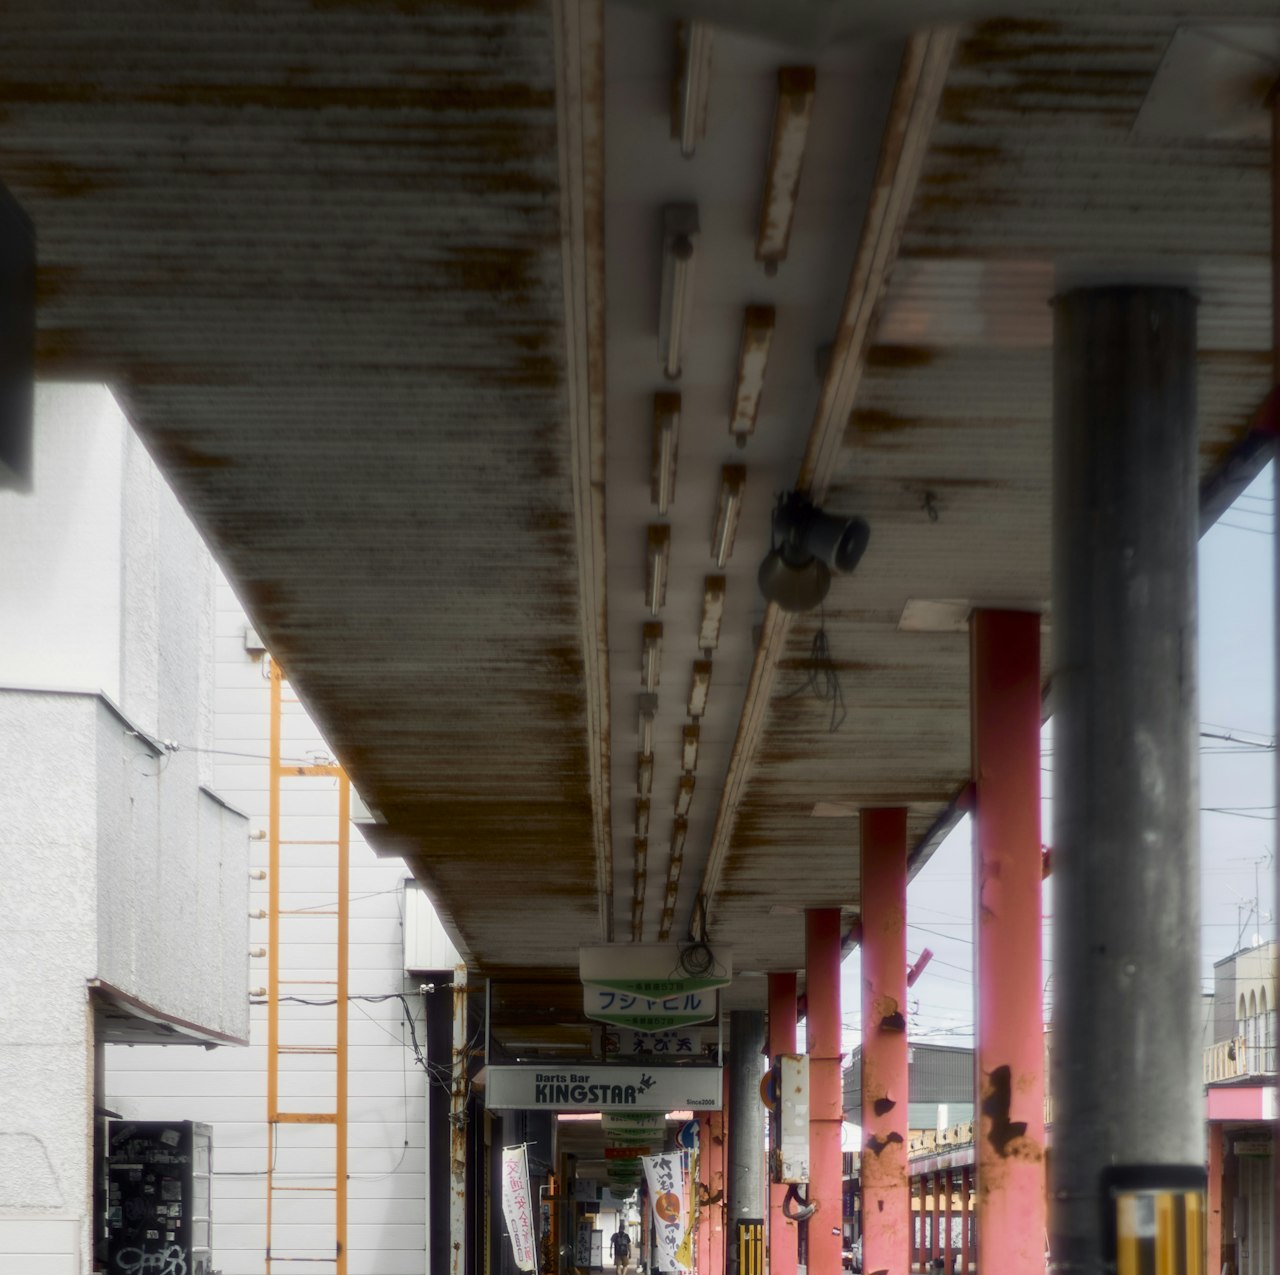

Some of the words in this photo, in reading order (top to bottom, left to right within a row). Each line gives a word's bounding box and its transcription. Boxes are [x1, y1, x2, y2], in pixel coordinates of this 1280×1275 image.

[535, 1074, 567, 1083] Darts
[570, 1074, 590, 1083] Bar
[535, 1084, 637, 1104] KINGSTAR
